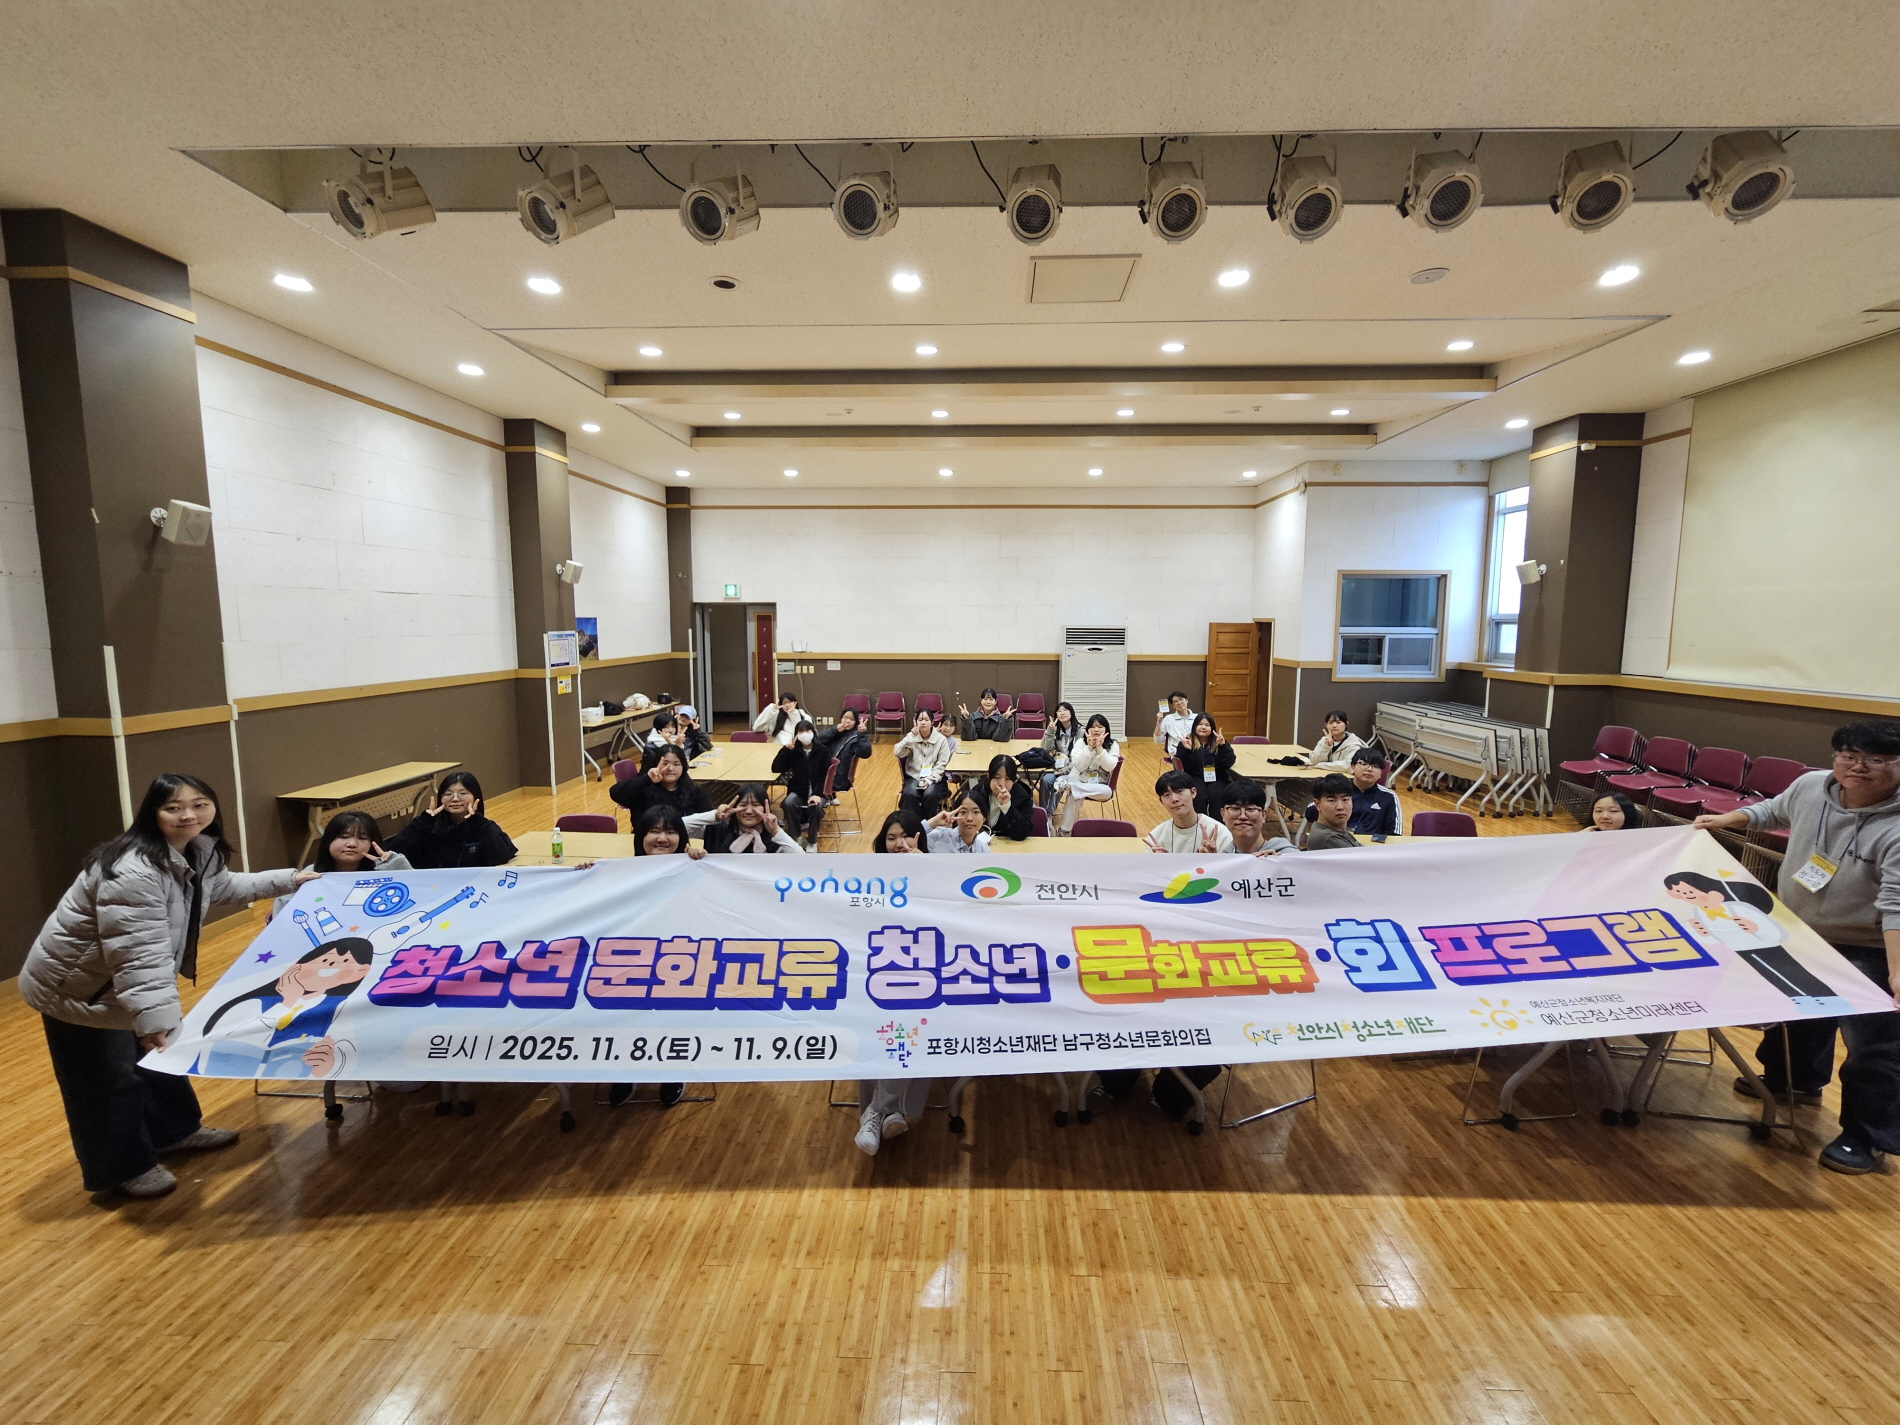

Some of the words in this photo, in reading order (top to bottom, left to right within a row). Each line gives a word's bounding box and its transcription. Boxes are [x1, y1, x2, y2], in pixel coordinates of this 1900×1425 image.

[774, 869, 909, 908] pohang
[1035, 883, 1100, 901] 천안시
[1231, 877, 1297, 899] 예산군
[849, 896, 885, 908] 포항시
[368, 937, 590, 1009] 청소년
[585, 936, 849, 1011] 문화교류
[1418, 908, 1720, 987] 프로그램
[1540, 1000, 1708, 1027] 예산군청소년미래센터
[427, 1035, 479, 1060] 일시
[499, 1035, 579, 1061] 2025.
[591, 1036, 620, 1061] 11.
[734, 1037, 762, 1061] 11.
[927, 1033, 1058, 1056] 포항시청소년재단
[1062, 1028, 1212, 1052] 남구청소년문화의집
